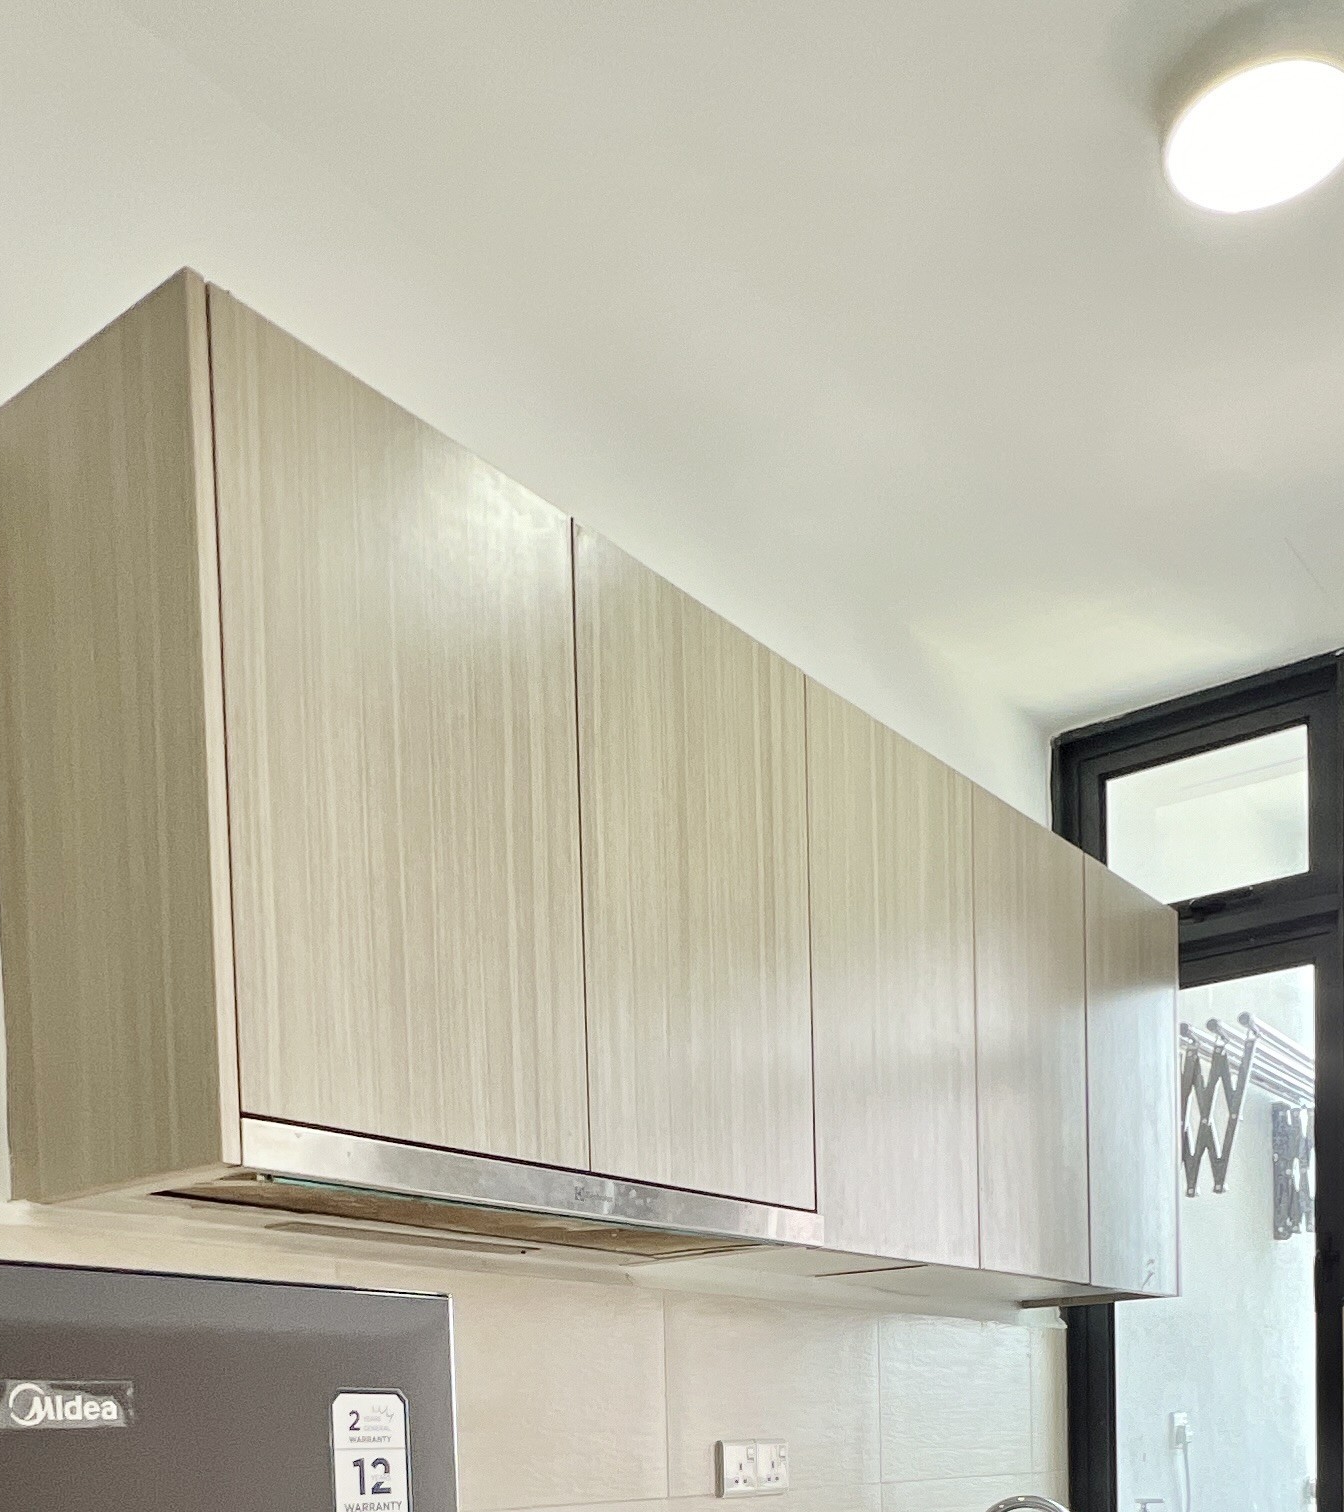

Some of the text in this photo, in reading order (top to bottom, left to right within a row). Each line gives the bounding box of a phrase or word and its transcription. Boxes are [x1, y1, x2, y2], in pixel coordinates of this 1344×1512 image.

[9, 1382, 118, 1427] Midea
[348, 1409, 361, 1432] 2
[349, 1435, 392, 1444] WARRANTY
[352, 1457, 392, 1496] 12
